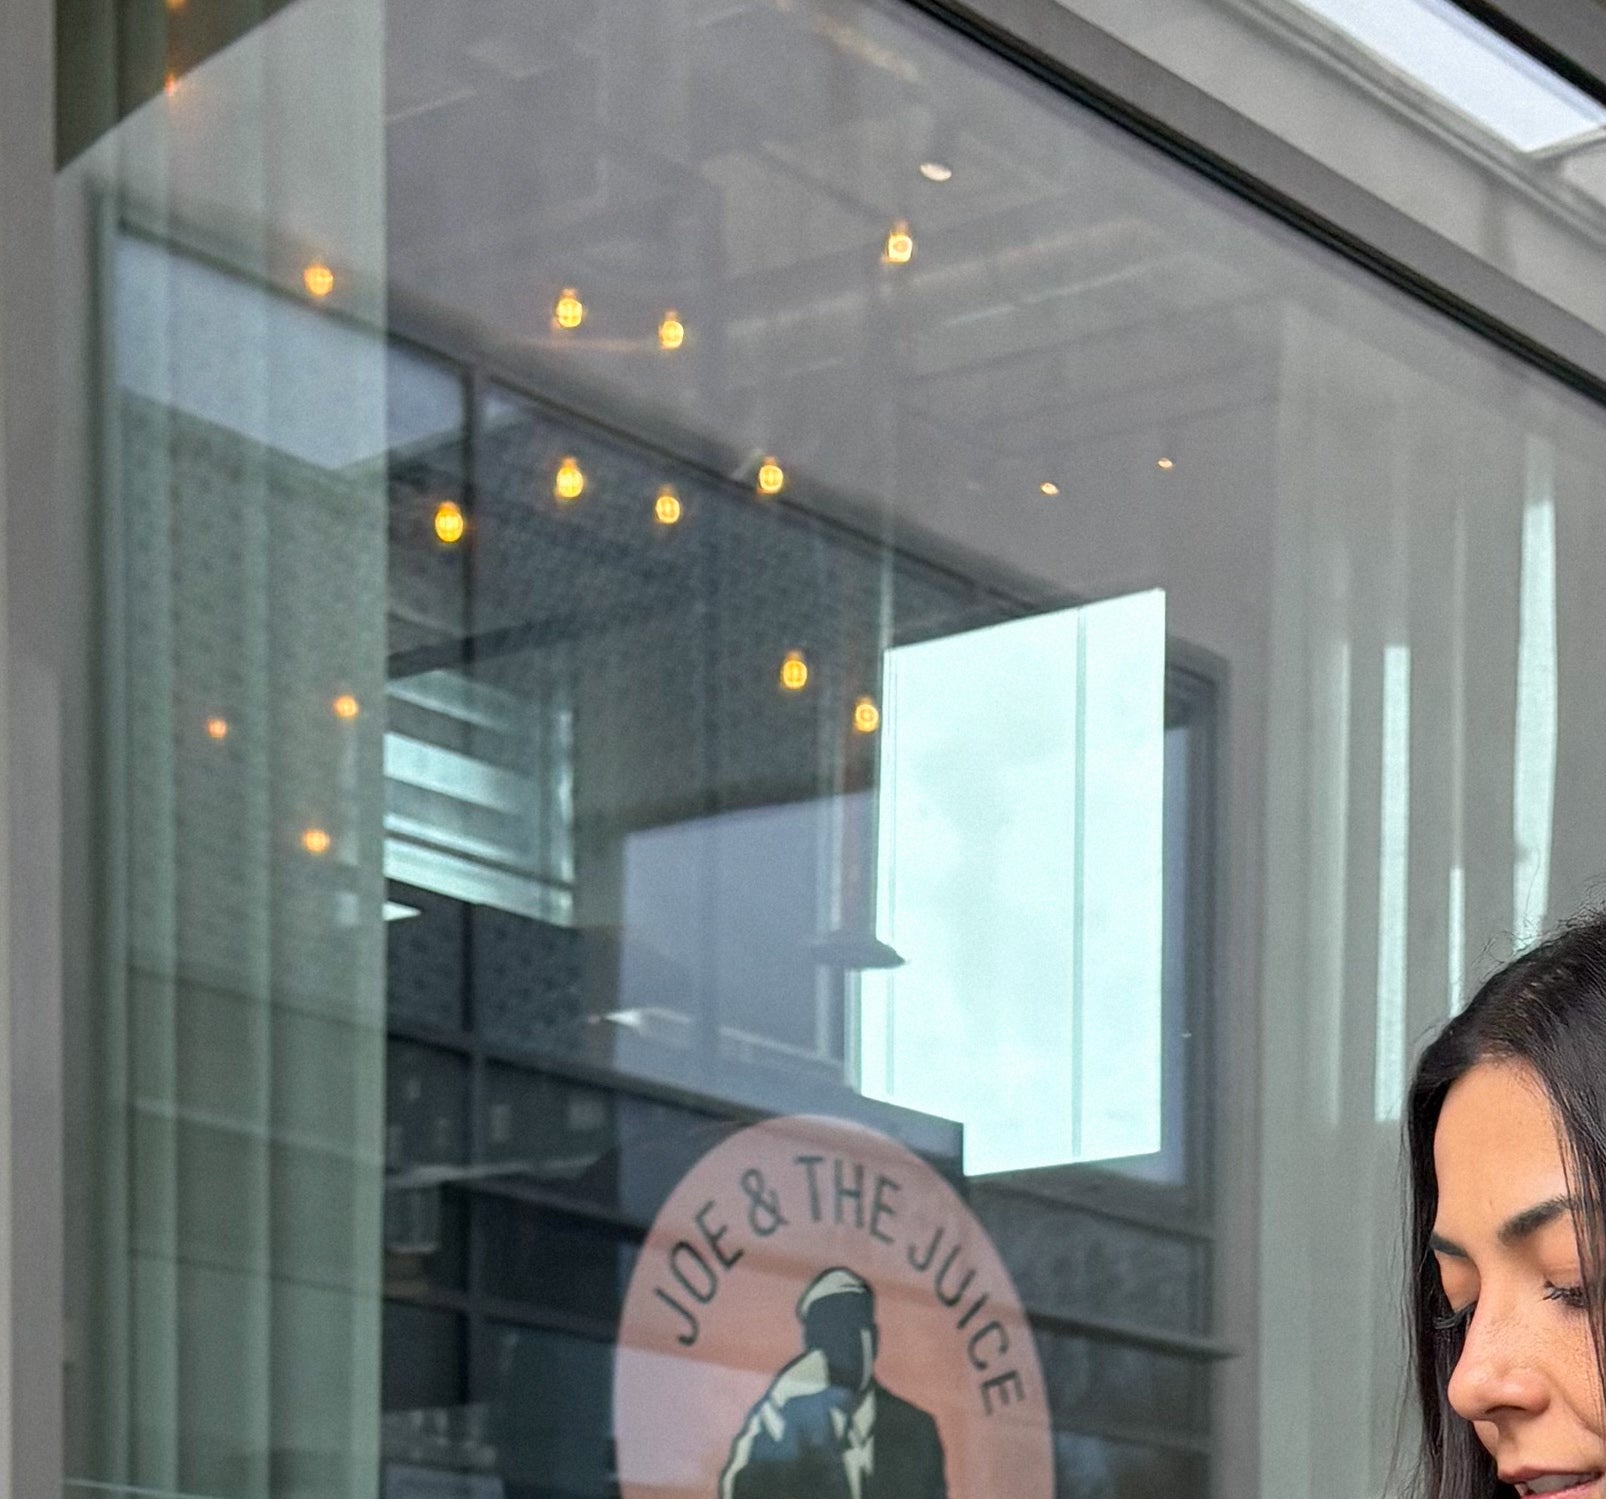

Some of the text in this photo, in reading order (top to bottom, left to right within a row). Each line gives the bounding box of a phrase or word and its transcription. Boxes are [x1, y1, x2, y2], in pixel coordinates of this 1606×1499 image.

[652, 1154, 1028, 1417] JOE & THE JUICE
